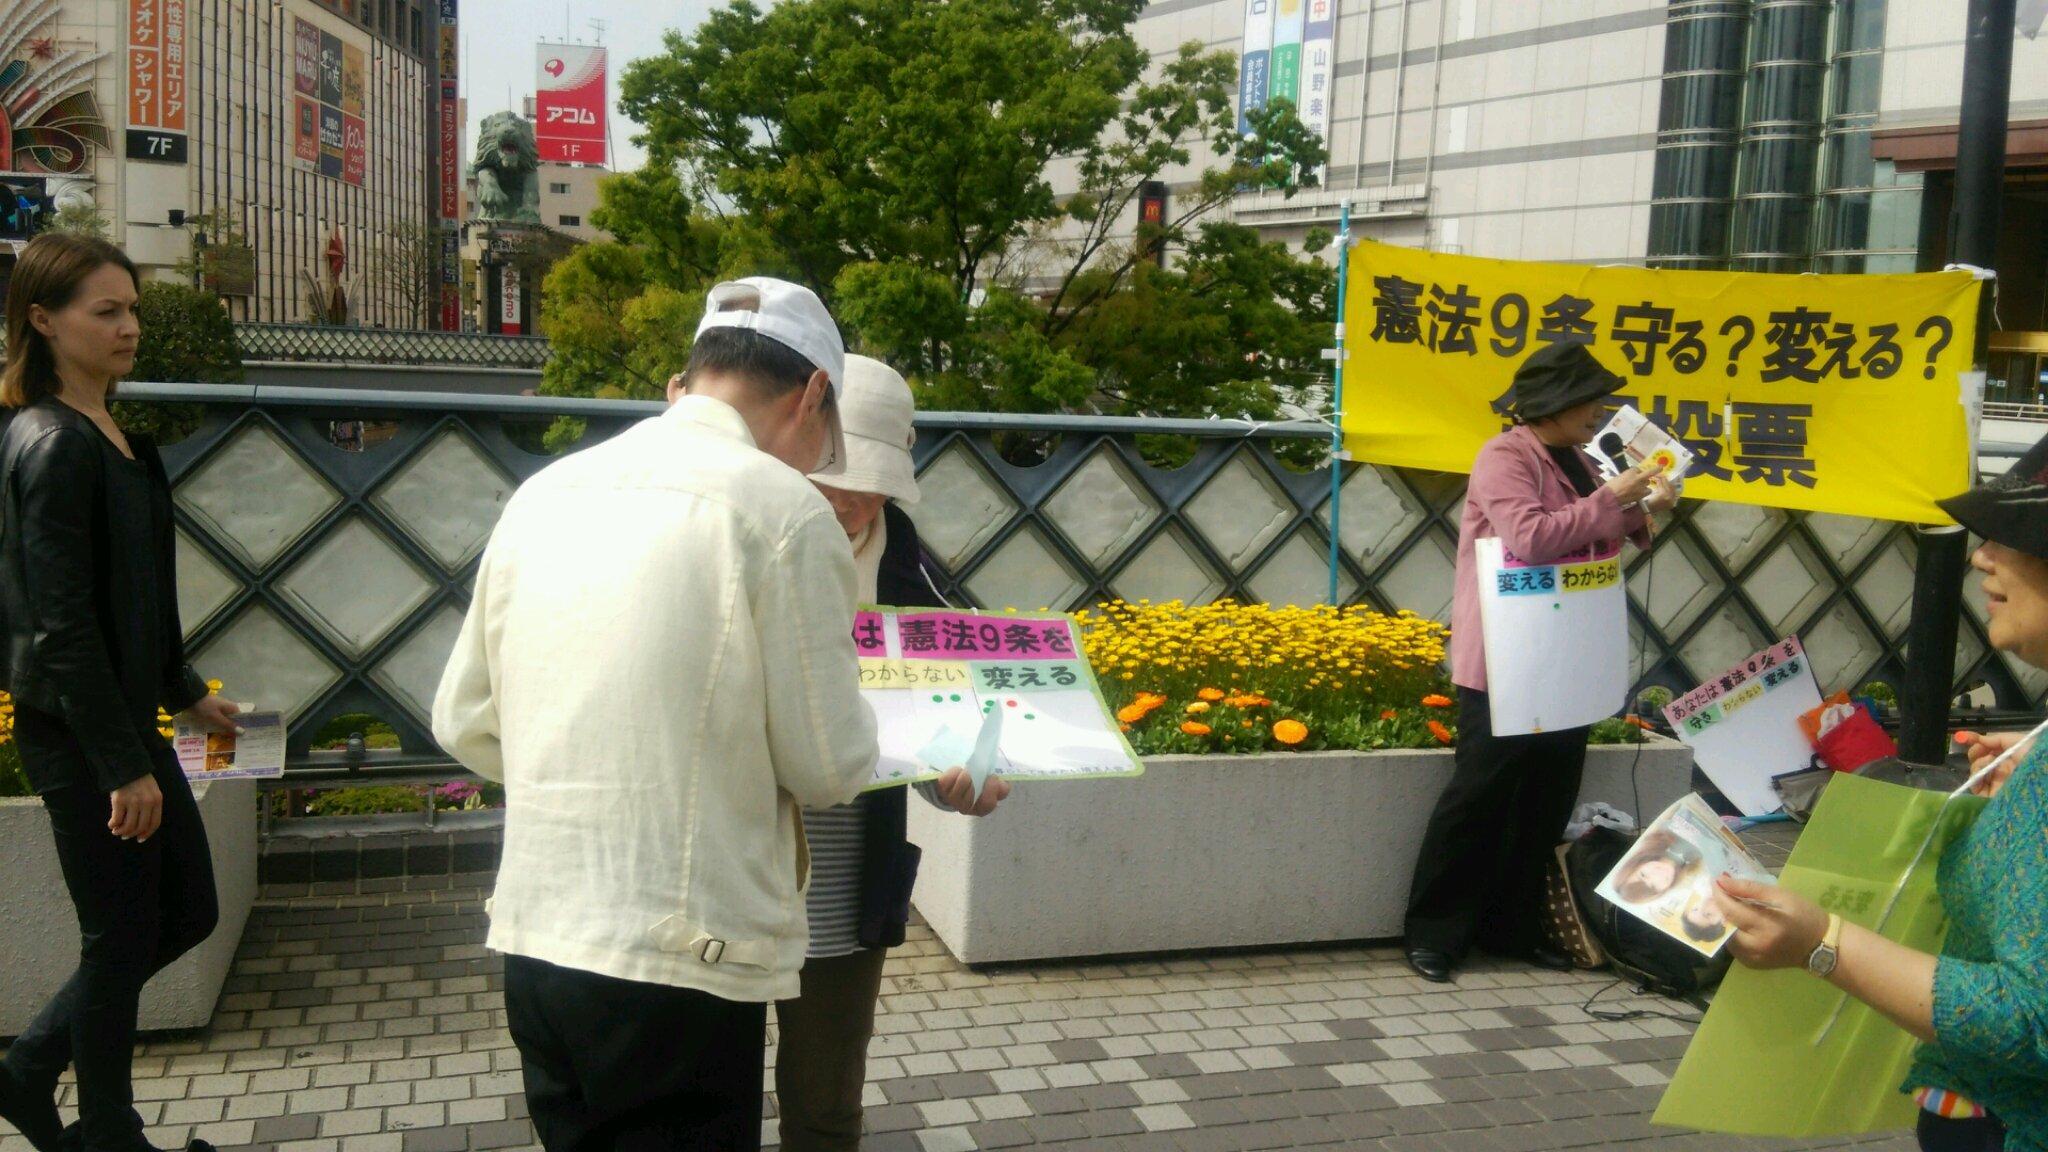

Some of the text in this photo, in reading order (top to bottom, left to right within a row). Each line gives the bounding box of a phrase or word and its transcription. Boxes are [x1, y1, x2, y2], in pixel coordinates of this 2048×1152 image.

[166, 0, 183, 118] 性専用エリア
[134, 53, 153, 123] シャワー
[546, 106, 595, 125] アコム
[147, 136, 173, 156] 7F
[562, 144, 580, 157] 1F
[1497, 571, 1555, 593] 変える
[859, 664, 1077, 690] わからない 変える
